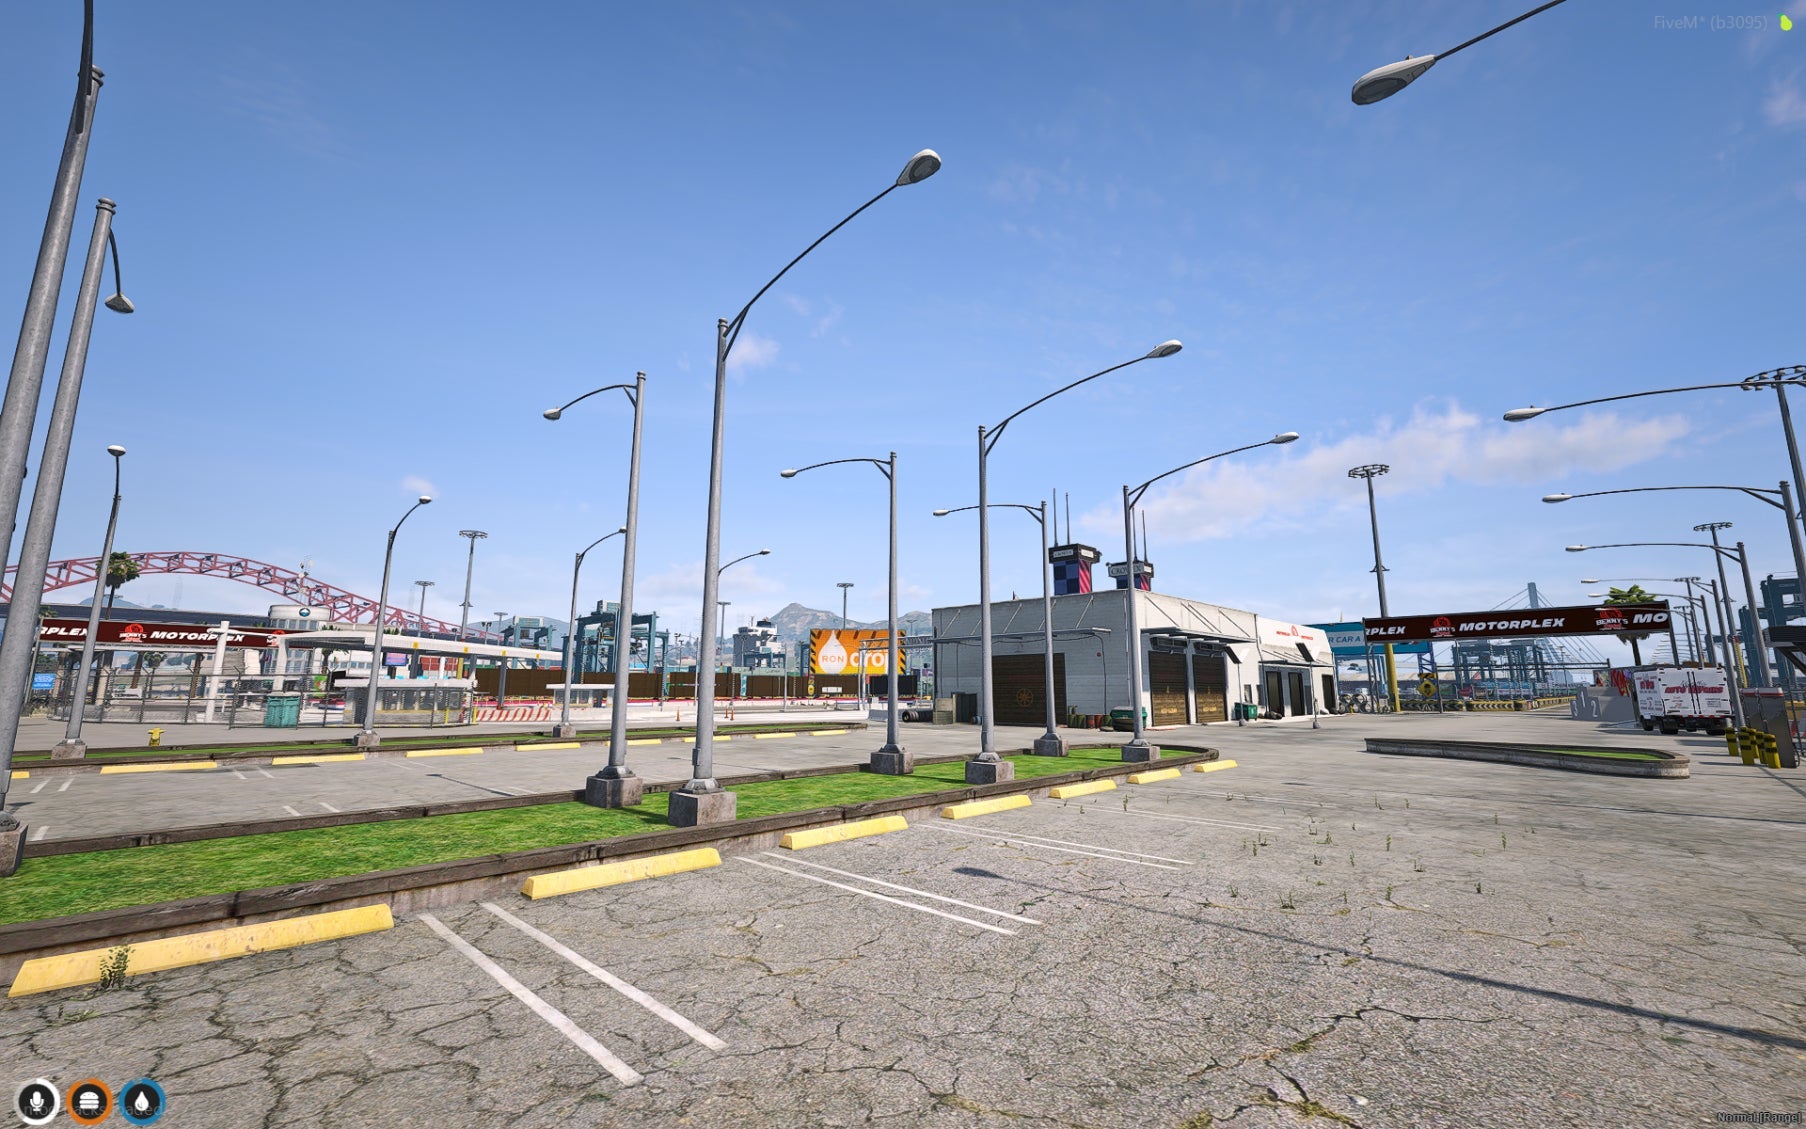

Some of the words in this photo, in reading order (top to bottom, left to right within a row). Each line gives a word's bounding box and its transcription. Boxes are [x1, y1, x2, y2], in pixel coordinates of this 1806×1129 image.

[1596, 617, 1628, 626] BENNY'S
[1632, 612, 1669, 625] MO
[1459, 617, 1566, 632] MOTORPLEX
[150, 630, 245, 643] MOTORPEX
[1335, 635, 1354, 643] CAR
[821, 655, 844, 663] RON
[1664, 686, 1687, 694] AUTO
[1590, 700, 1599, 718] 2
